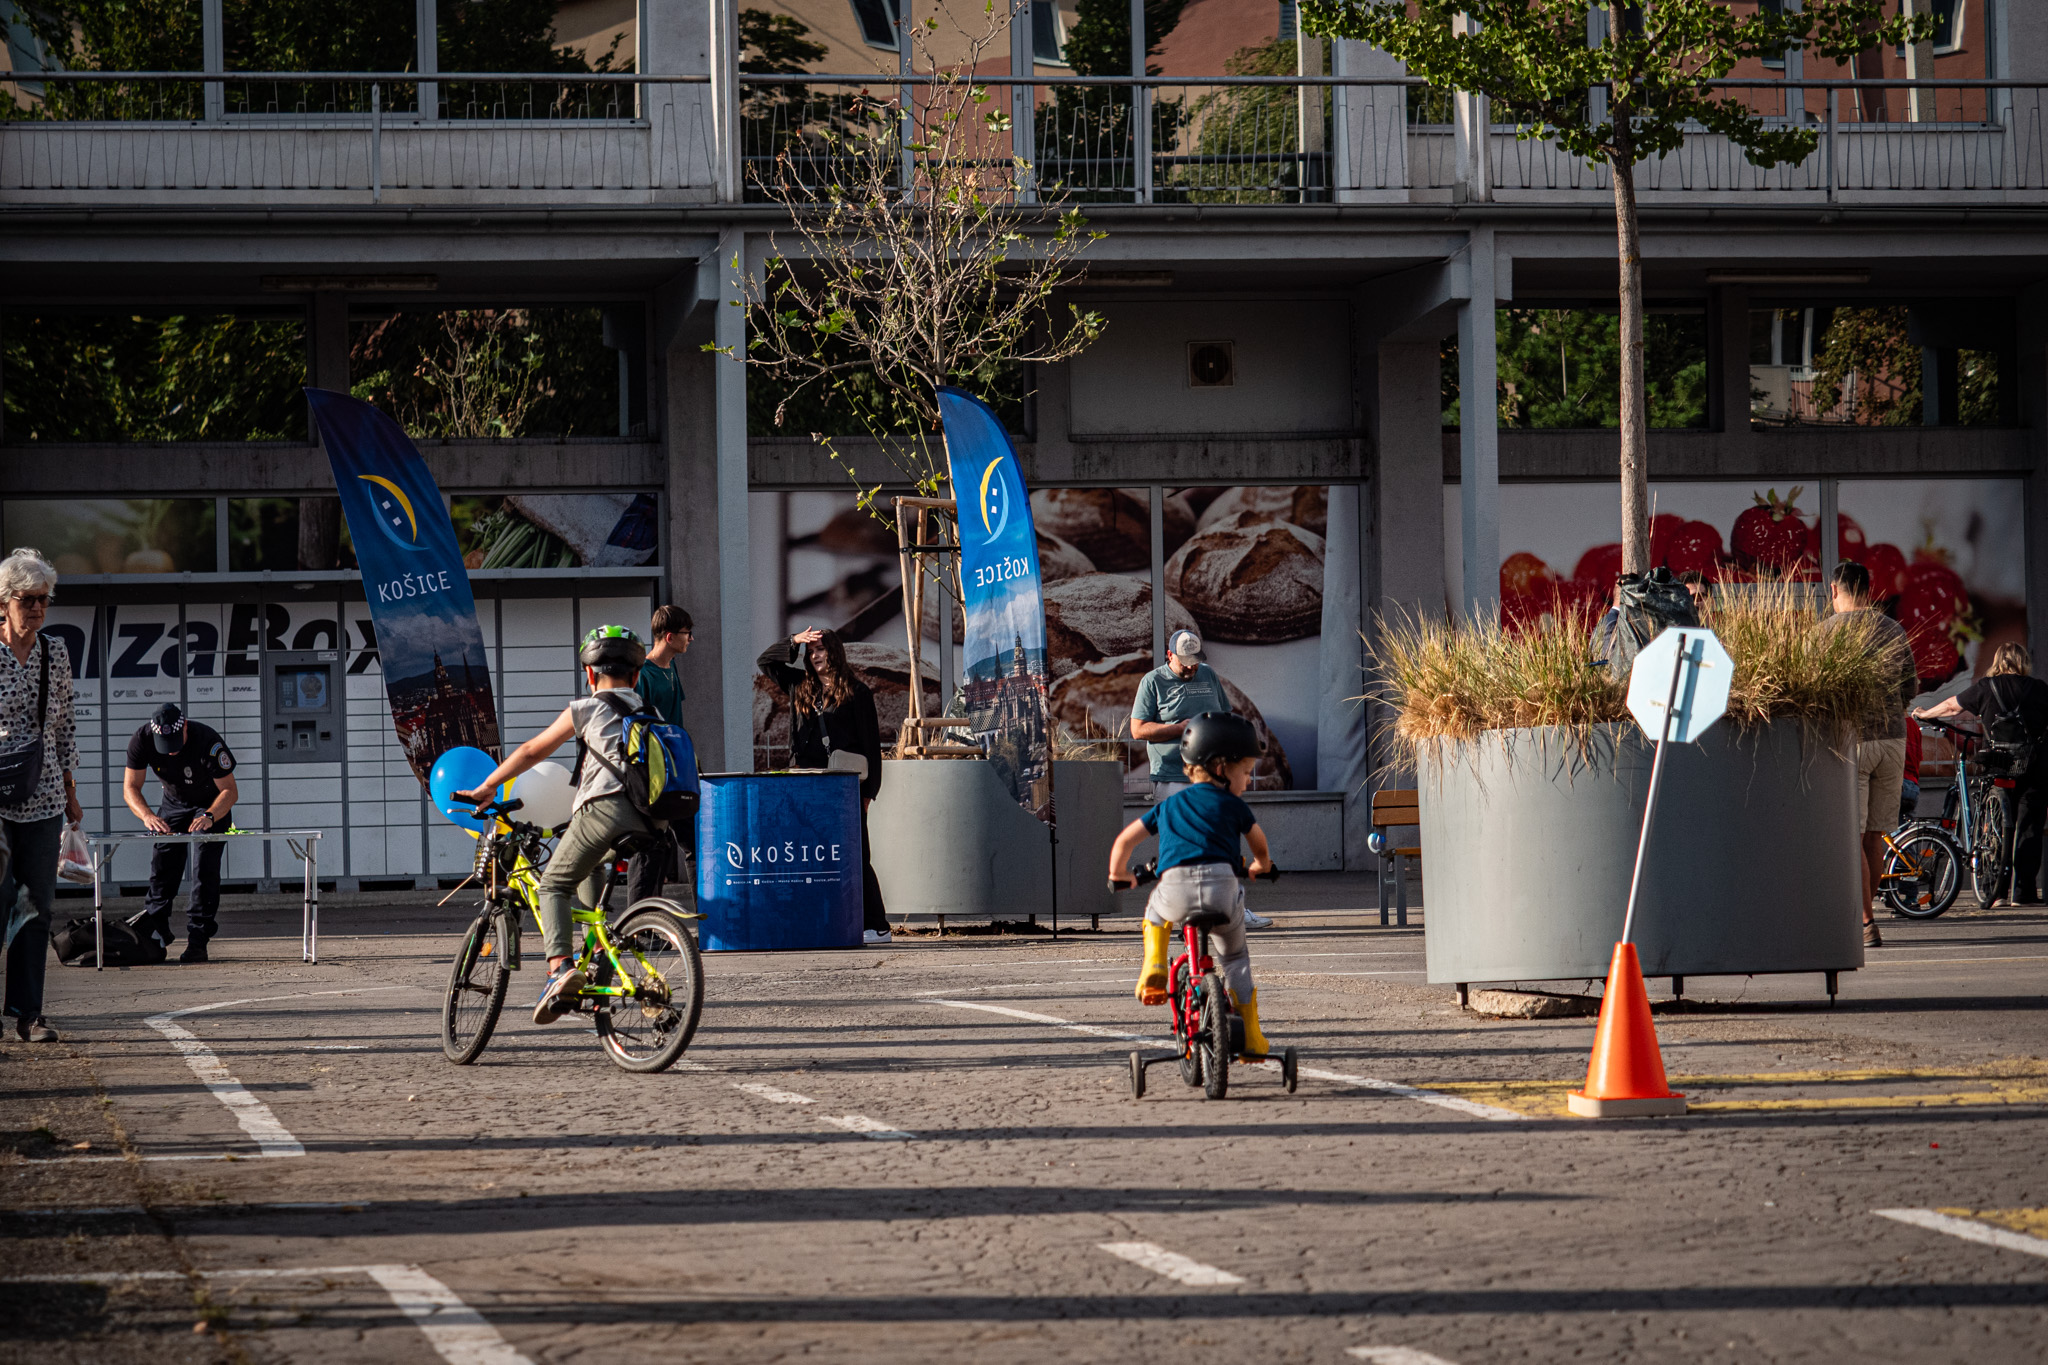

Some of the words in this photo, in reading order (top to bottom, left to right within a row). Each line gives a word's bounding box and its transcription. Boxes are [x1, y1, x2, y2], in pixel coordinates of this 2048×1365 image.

[378, 571, 451, 602] KOŠICE
[81, 691, 93, 699] dpd
[0, 783, 16, 791] OXY
[751, 841, 841, 864] KOŠICE
